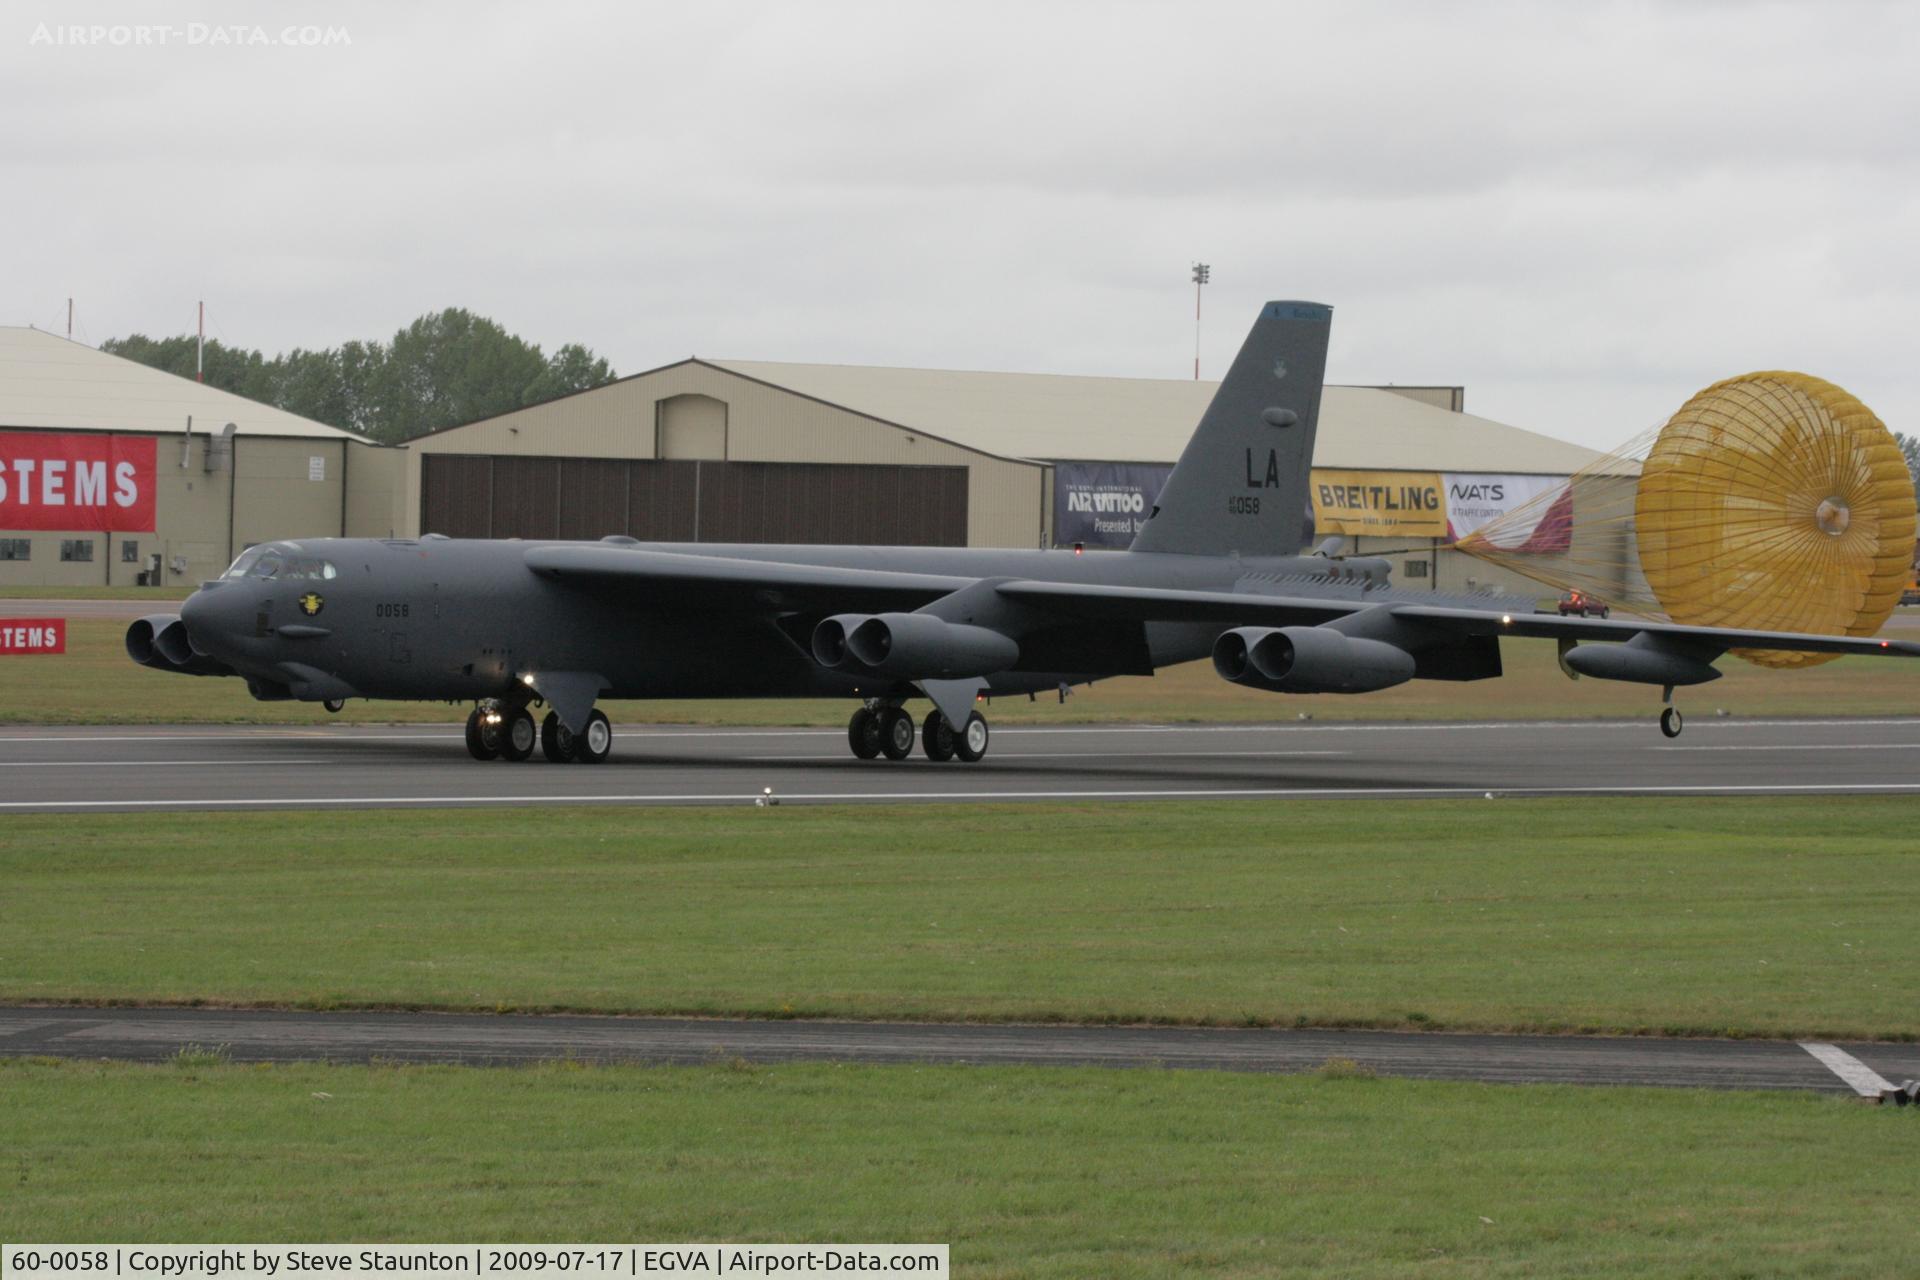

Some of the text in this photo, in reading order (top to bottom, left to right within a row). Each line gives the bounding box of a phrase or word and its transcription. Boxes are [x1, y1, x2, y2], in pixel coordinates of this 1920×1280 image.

[1246, 448, 1280, 489] LA
[1318, 485, 1440, 510] BREITLING
[1450, 484, 1504, 501] NATS
[1068, 492, 1144, 513] AIR TATTOO
[1237, 496, 1260, 515] 058
[1094, 518, 1131, 533] Presented
[376, 604, 409, 617] 0058
[0, 628, 57, 648] TEMS
